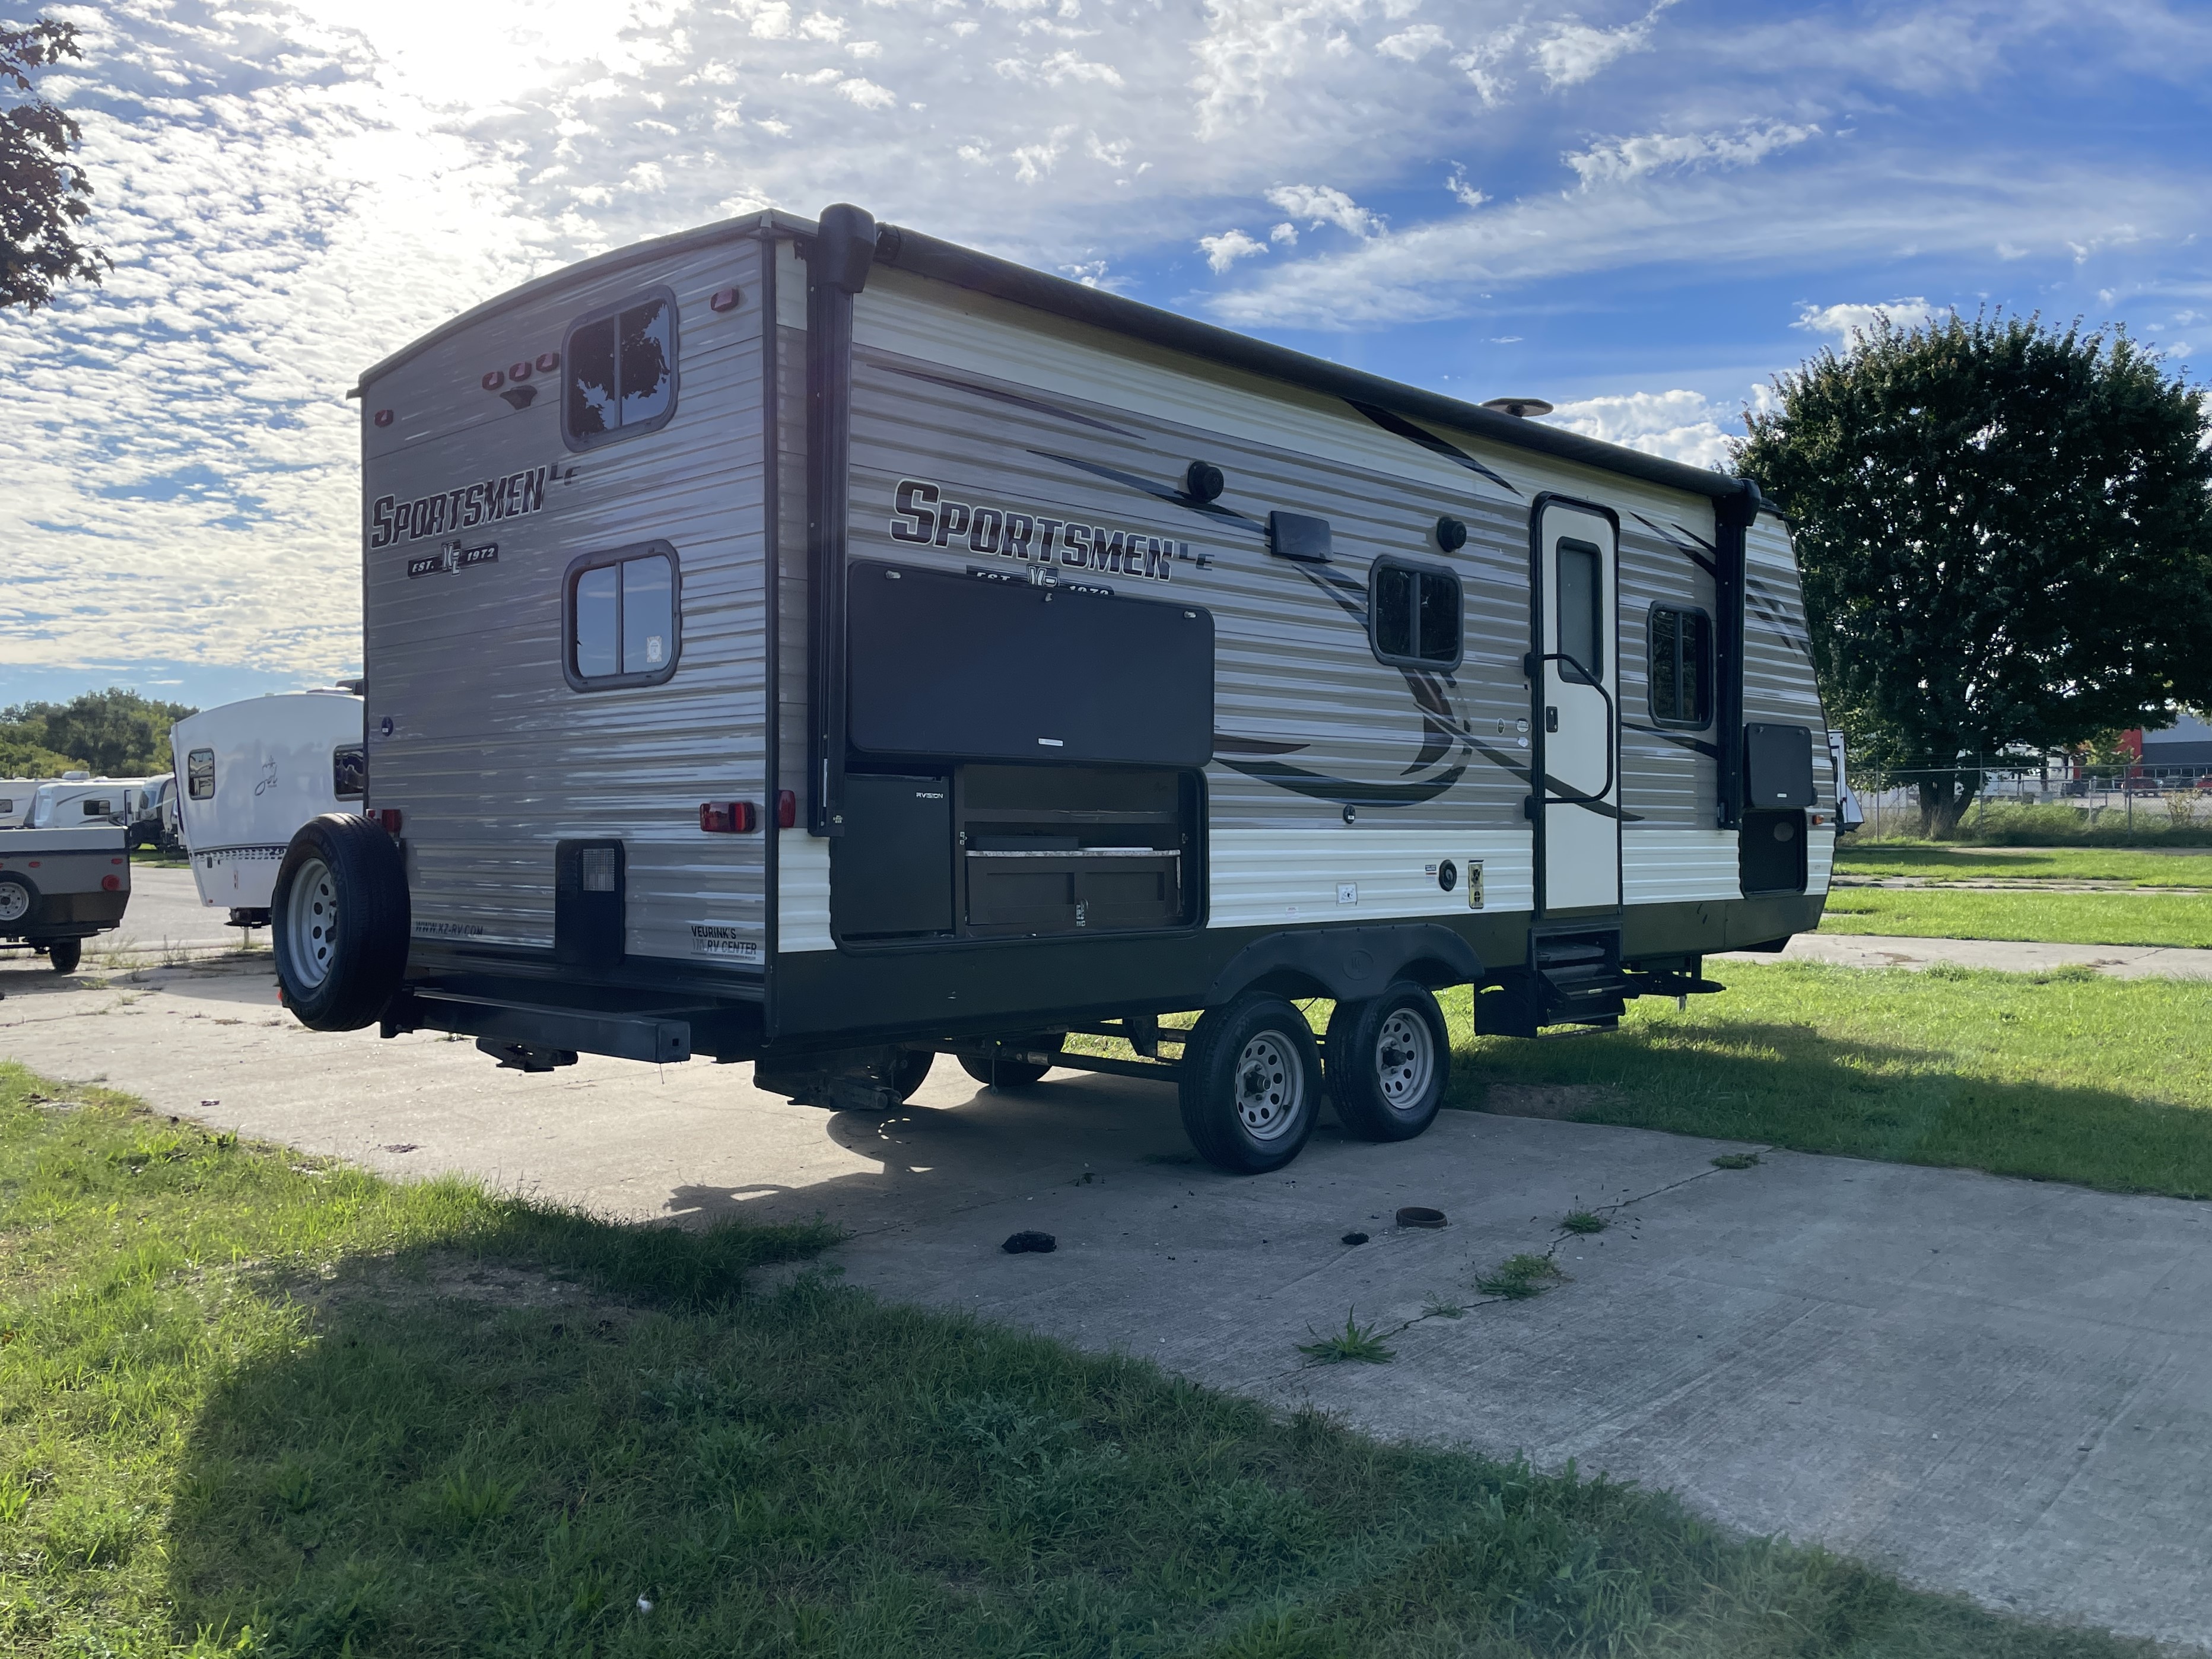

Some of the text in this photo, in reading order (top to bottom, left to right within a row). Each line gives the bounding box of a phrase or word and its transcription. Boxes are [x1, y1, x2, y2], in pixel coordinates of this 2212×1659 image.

[371, 465, 546, 549] SPORTSMEN
[890, 478, 1215, 581] SPORTSMEN LE
[412, 560, 435, 573] EST.
[466, 547, 495, 562] 1972
[691, 925, 737, 939] VEURINK'S
[707, 939, 720, 952] RV
[722, 940, 757, 955] CENTER
